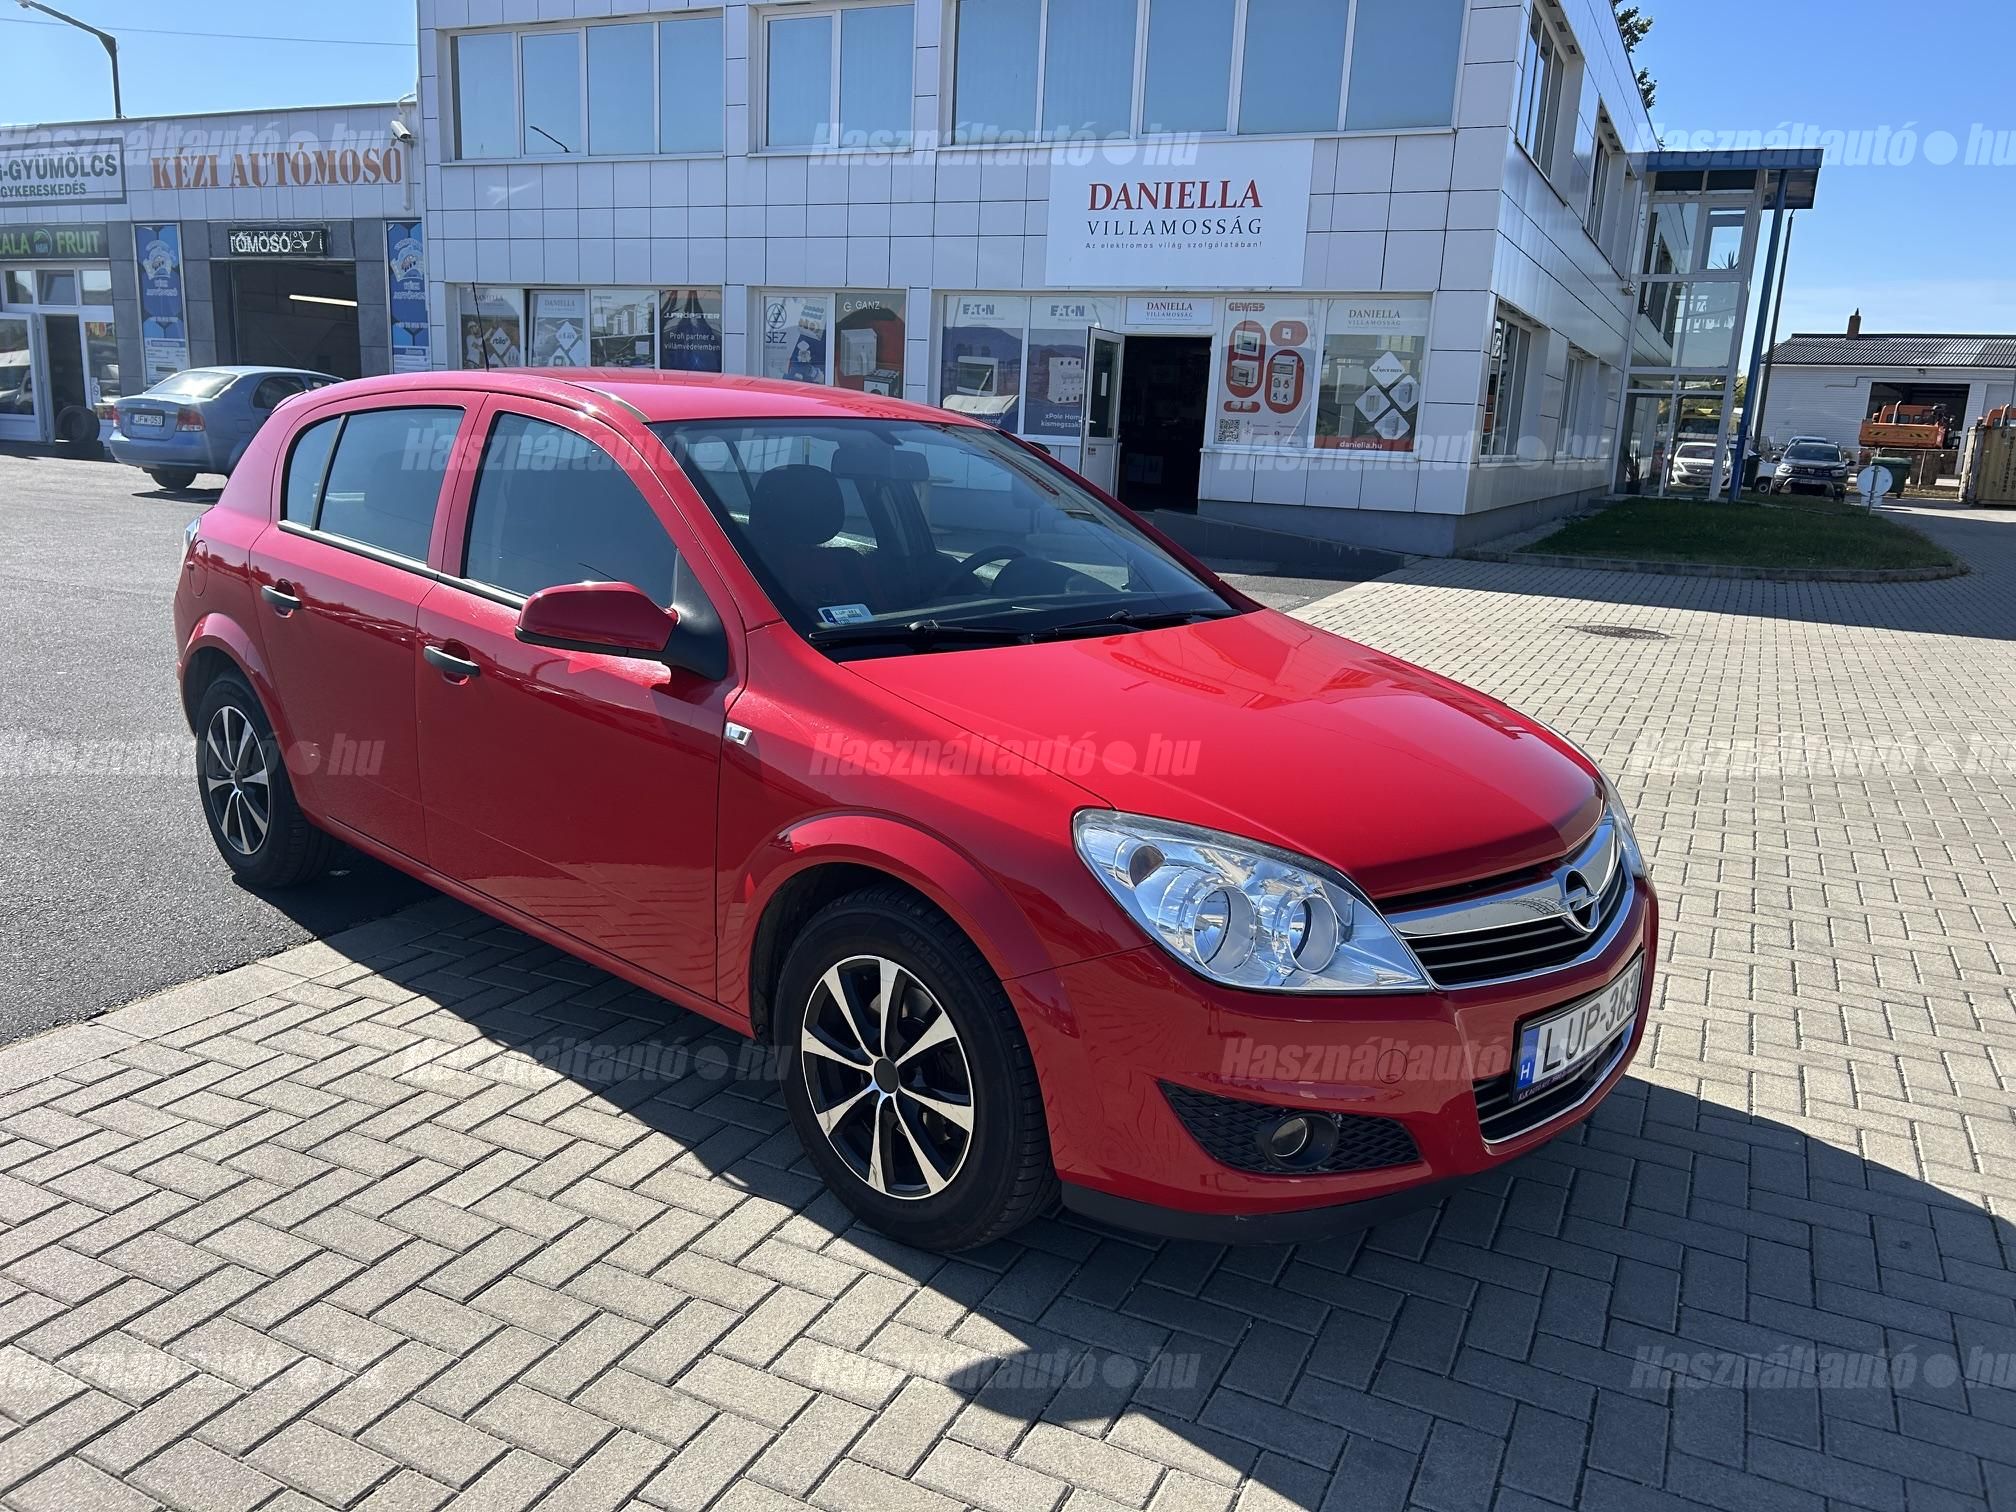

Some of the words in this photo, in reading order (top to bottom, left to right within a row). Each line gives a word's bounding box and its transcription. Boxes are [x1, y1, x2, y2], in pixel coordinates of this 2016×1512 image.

[0, 151, 117, 181] -GYÜMÖLCS
[151, 146, 219, 190] KÉZI
[229, 143, 402, 187] AUTÓMOSÓ
[1087, 179, 1263, 211] DANIELLA
[1087, 215, 1262, 236] VILLAMOSSÁG
[0, 231, 31, 255] ALA
[56, 230, 100, 254] FRUIT
[1158, 240, 1182, 250] világ
[855, 300, 880, 310] GANZ
[962, 304, 995, 315] EATON
[1050, 305, 1085, 317] EATON
[1146, 302, 1193, 311] DANIELLA
[1228, 302, 1266, 312] GEWISS
[1348, 309, 1401, 319] DANIELLA
[669, 332, 685, 340] Profi
[686, 333, 710, 341] partner
[765, 331, 787, 344] SEZ
[1520, 1062, 1531, 1081] H
[1542, 966, 1639, 1073] LUP-383
